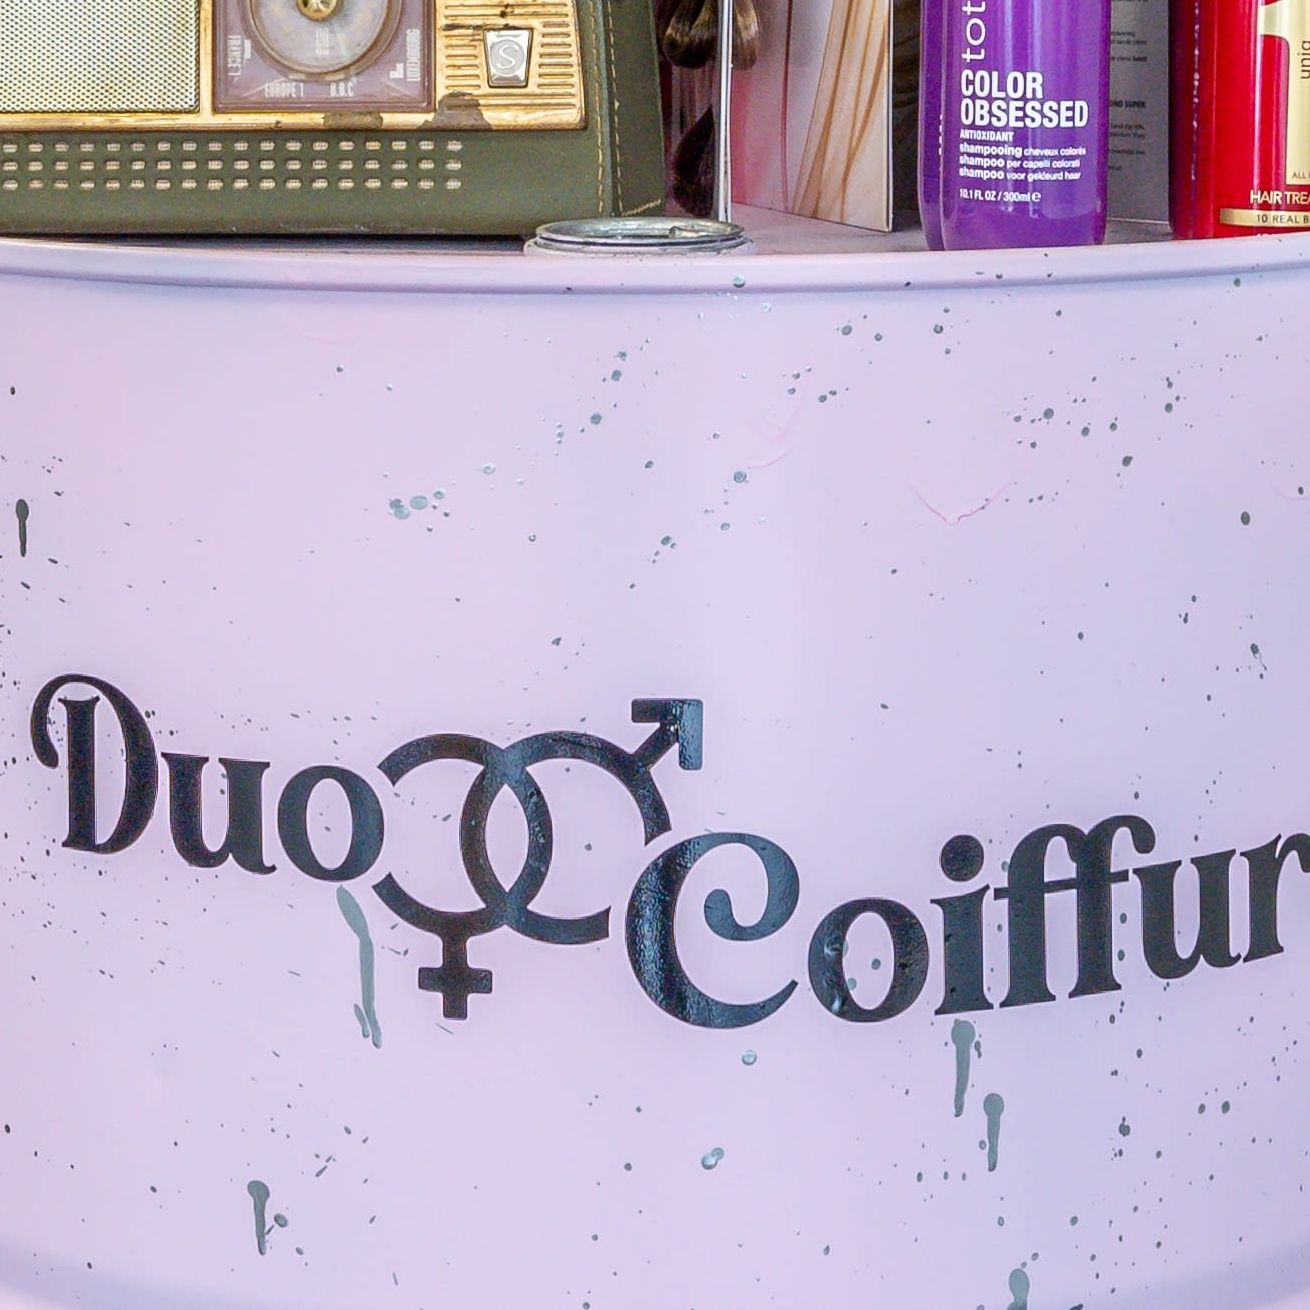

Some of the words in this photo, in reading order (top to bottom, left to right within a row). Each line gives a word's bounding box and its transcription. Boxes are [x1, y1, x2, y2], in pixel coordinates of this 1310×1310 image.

[961, 69, 1043, 98] COLOR
[960, 98, 1089, 128] OBSESSED
[960, 129, 1014, 141] ANTIOXIDANT
[959, 142, 1023, 158] shampooing
[959, 154, 1005, 168] shampoo
[959, 167, 1005, 181] shampoo
[1250, 190, 1282, 204] HAIR
[1257, 214, 1268, 222] 10
[1272, 215, 1299, 223] REAL
[31, 672, 385, 882] Duo
